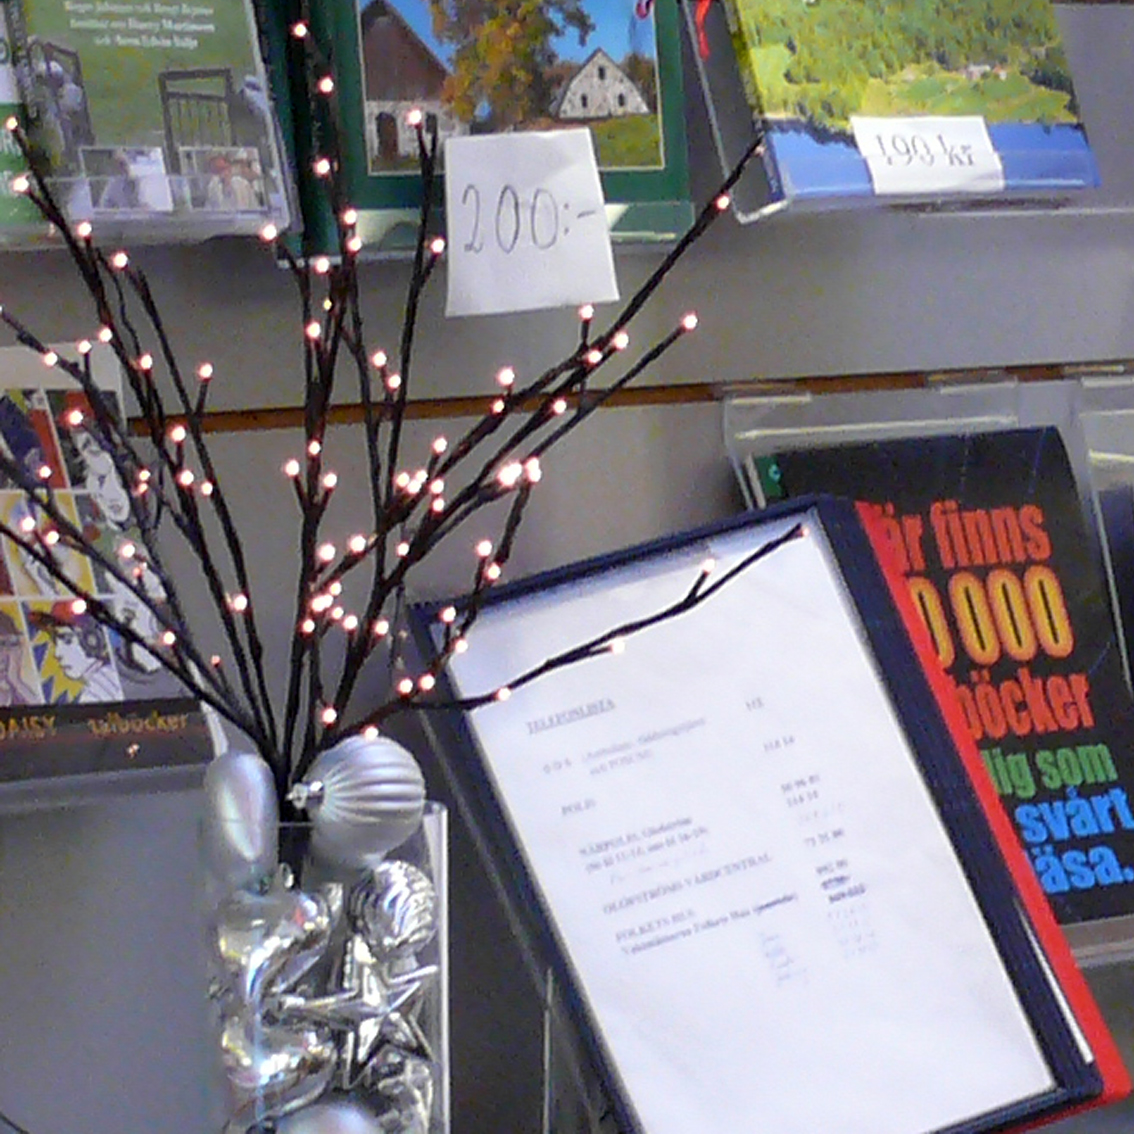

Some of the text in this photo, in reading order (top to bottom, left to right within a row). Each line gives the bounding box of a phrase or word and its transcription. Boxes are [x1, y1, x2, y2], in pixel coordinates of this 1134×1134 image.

[876, 133, 975, 167] 190 kr
[462, 183, 596, 255] 200:-
[874, 499, 1053, 571] är finns
[949, 564, 1075, 666] 000
[1035, 742, 1119, 790] som
